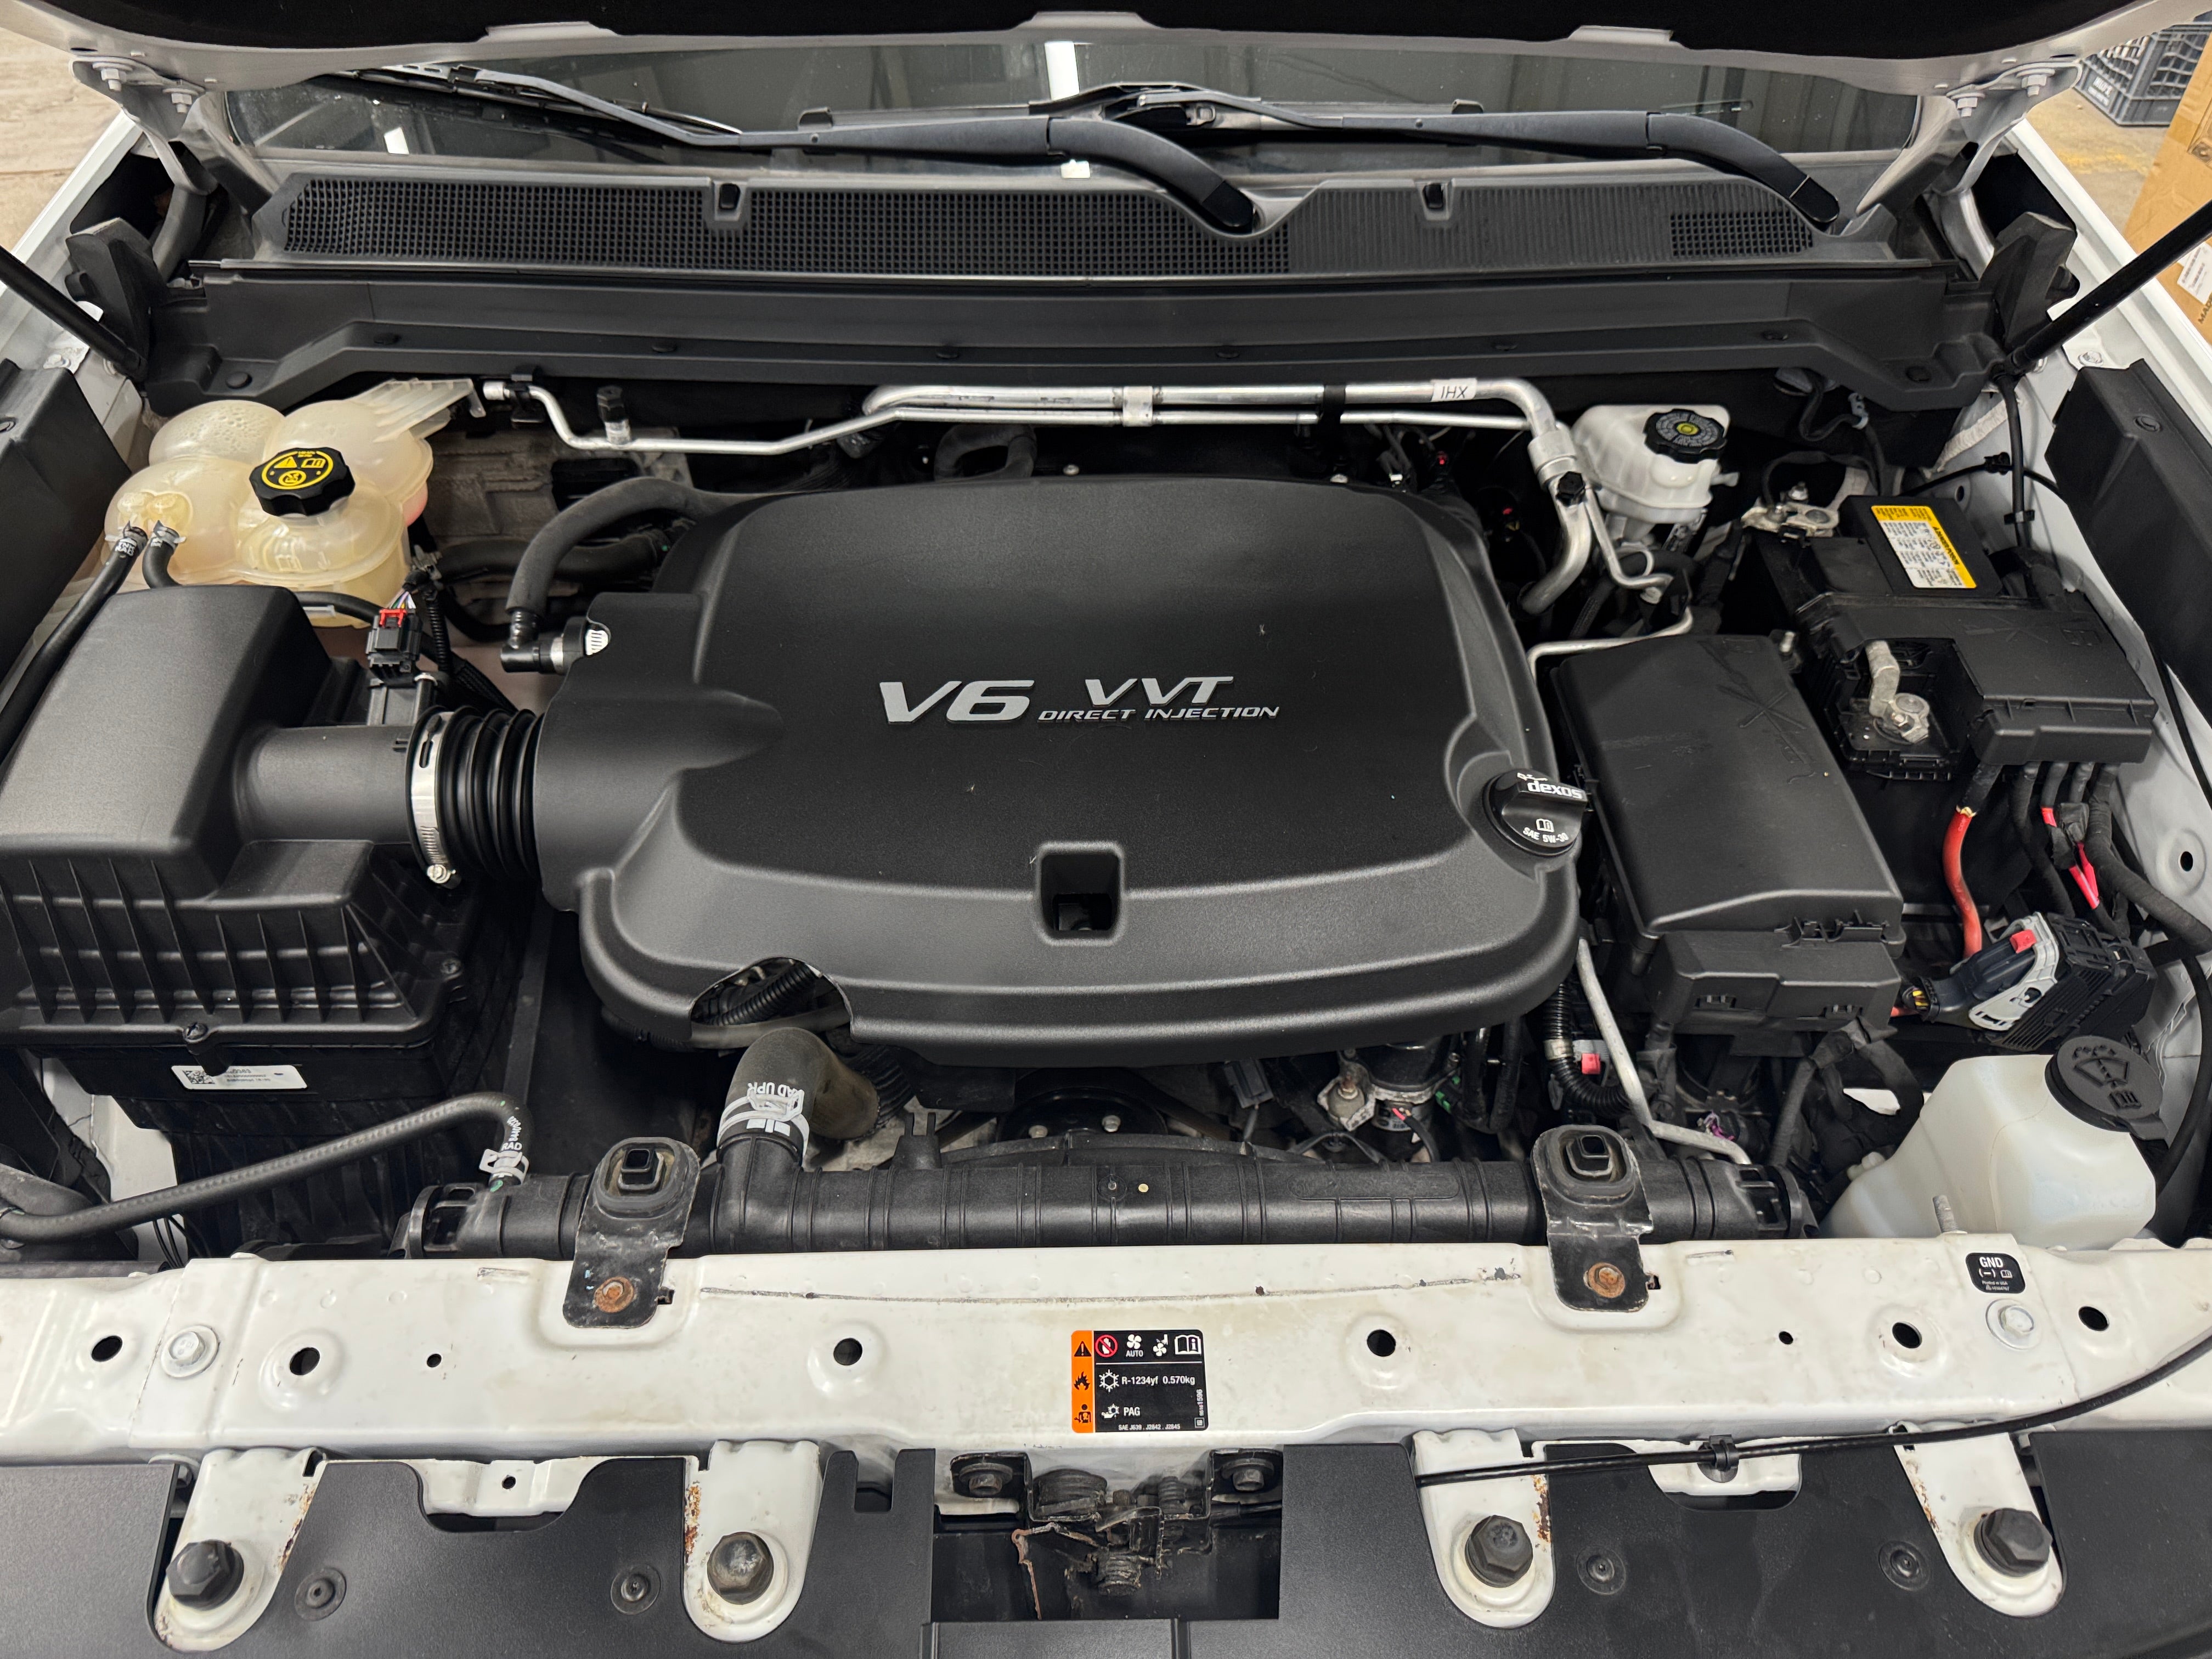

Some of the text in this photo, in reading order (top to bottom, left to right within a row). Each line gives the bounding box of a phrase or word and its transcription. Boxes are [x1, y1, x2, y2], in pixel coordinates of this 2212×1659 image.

[1441, 386, 1468, 399] IHX
[1085, 676, 1234, 707] VVT
[879, 680, 1035, 723] V6
[1037, 706, 1280, 723] DIRECT INJECTION
[1527, 780, 1583, 799] dexos
[1522, 827, 1569, 844] SAE 5W-30
[500, 1142, 522, 1151] RAD
[1979, 1256, 2004, 1268] GND
[1121, 1375, 1195, 1386] R-1234yf 0.570kg
[1123, 1407, 1141, 1416] PAG
